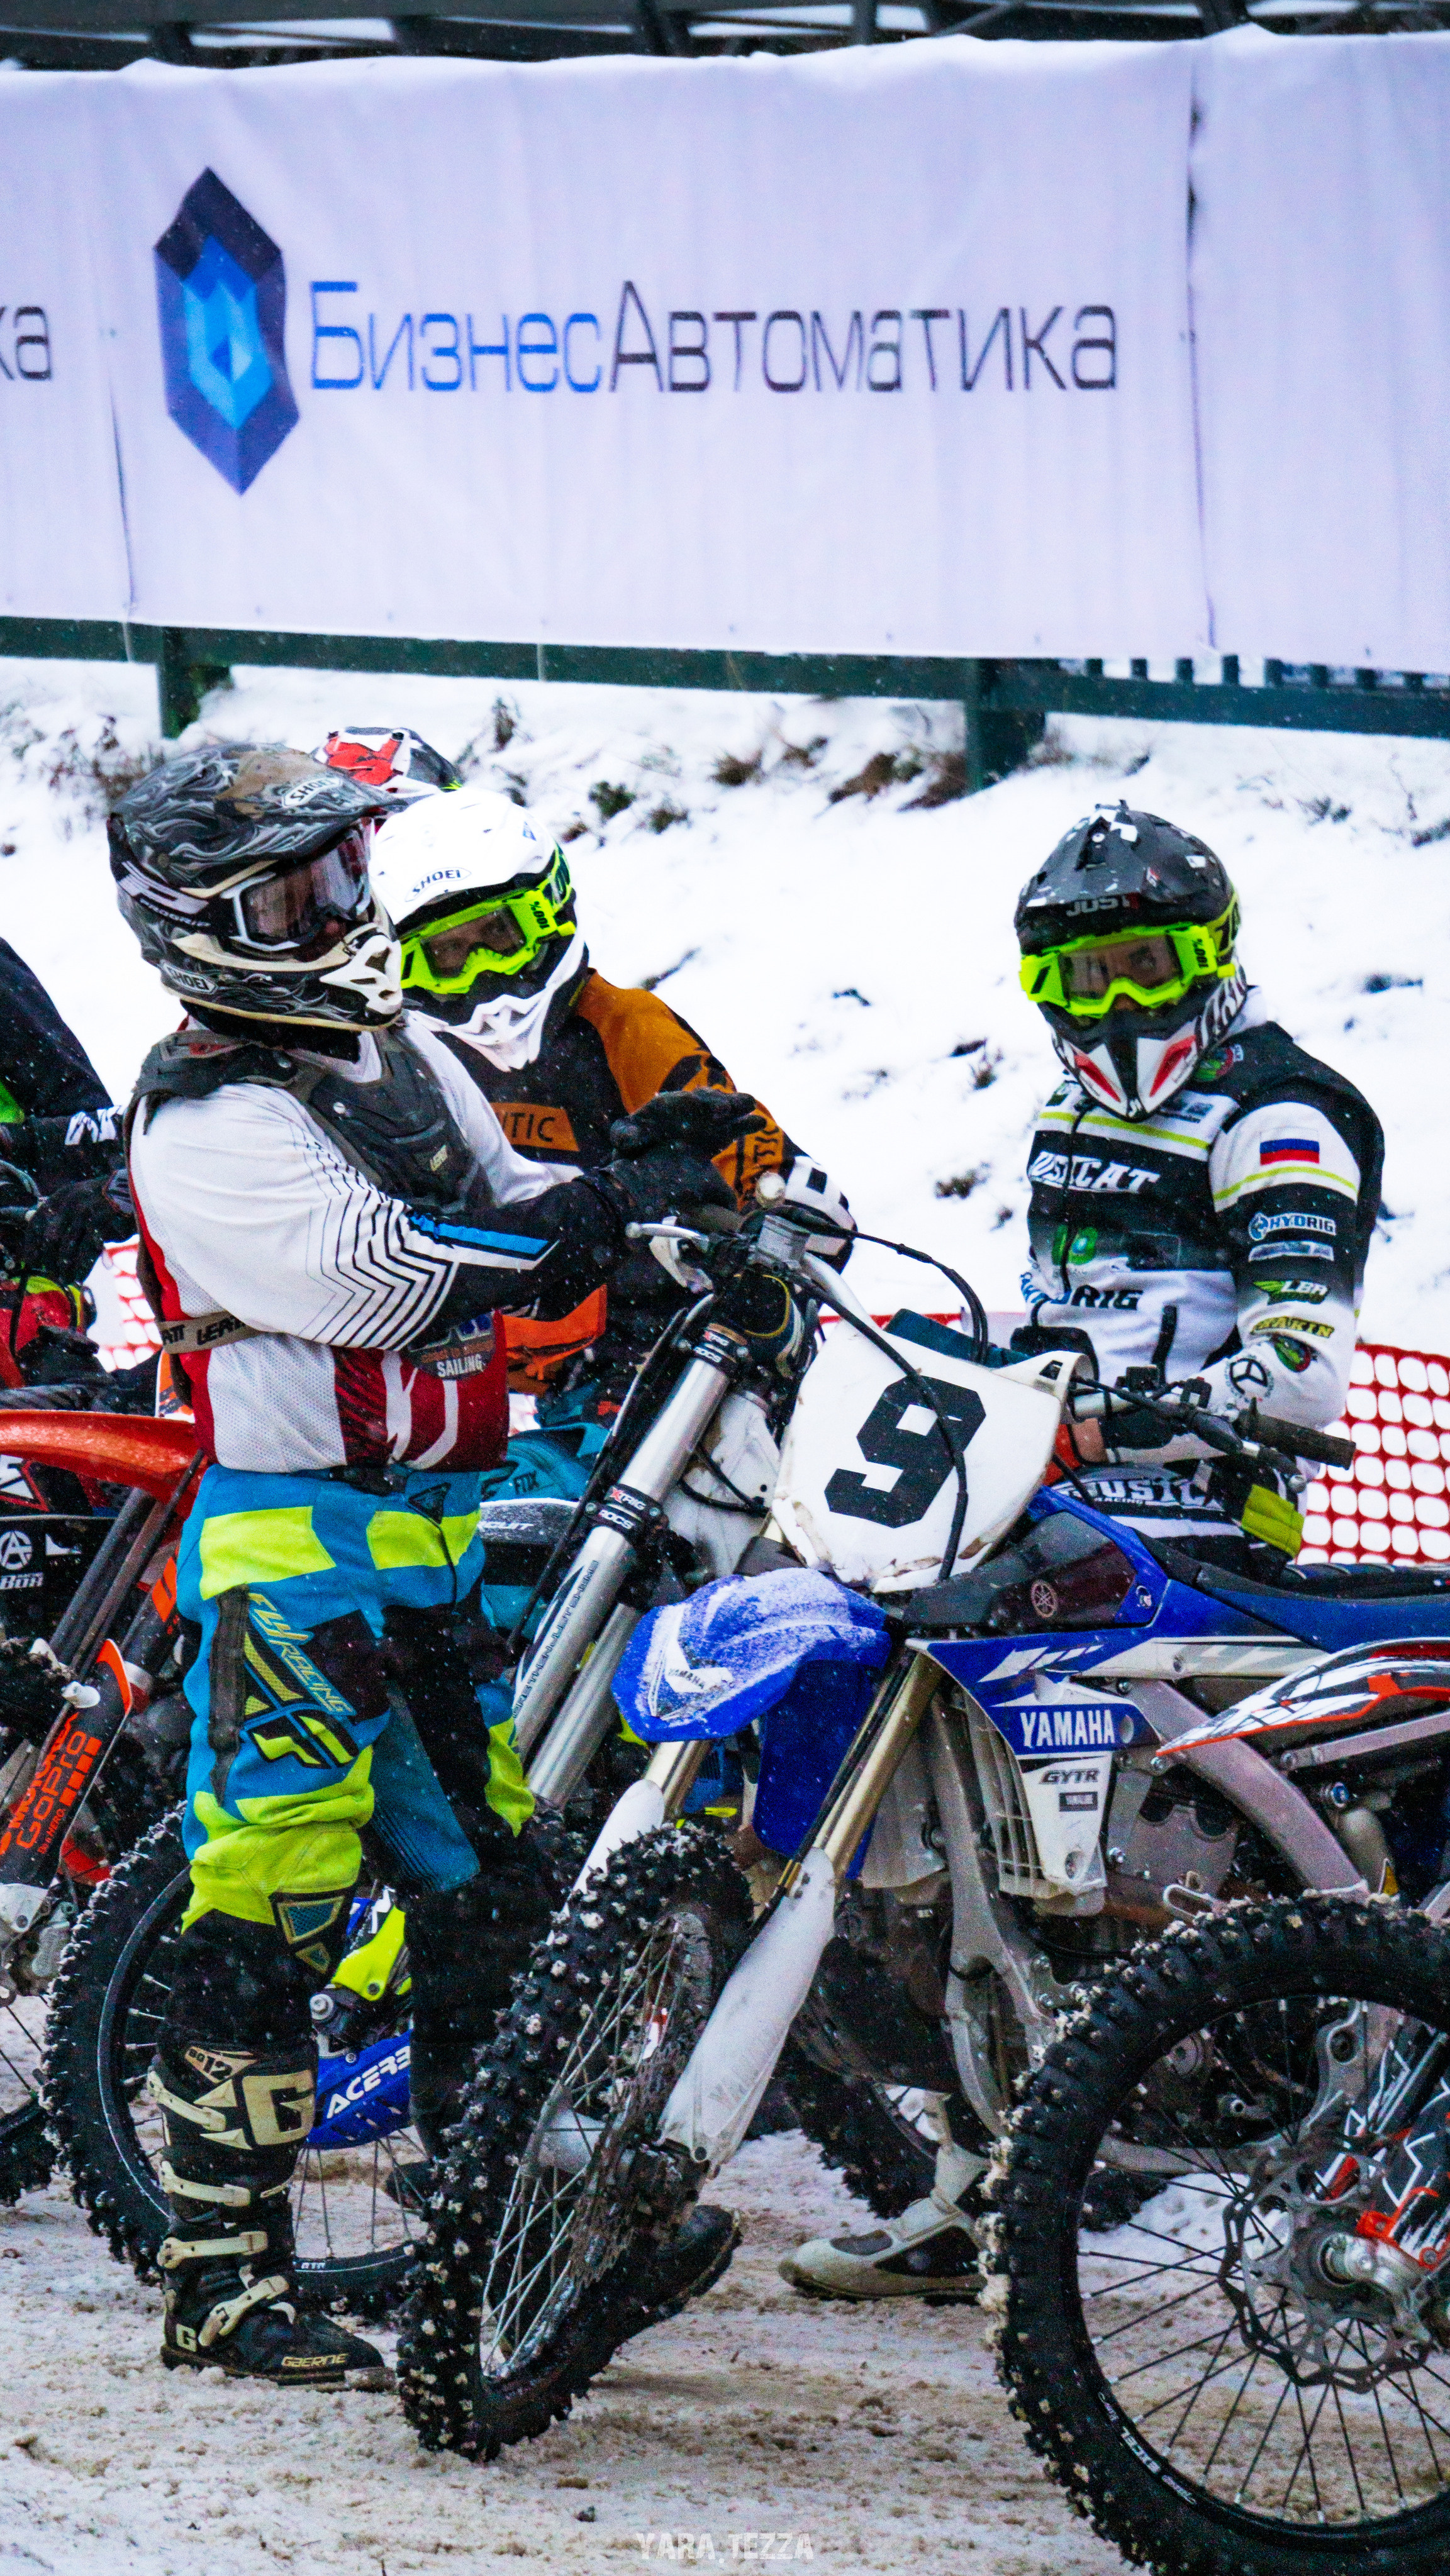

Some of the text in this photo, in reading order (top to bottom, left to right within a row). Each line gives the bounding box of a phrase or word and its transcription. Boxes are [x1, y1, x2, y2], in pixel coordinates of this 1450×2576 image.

[411, 869, 462, 896] SHOEI
[529, 901, 550, 930] 100%
[437, 1353, 484, 1377] SAILING
[824, 1374, 986, 1529] 9
[1019, 1709, 1116, 1748] YAMAHA
[16, 1730, 87, 1849] GoPro
